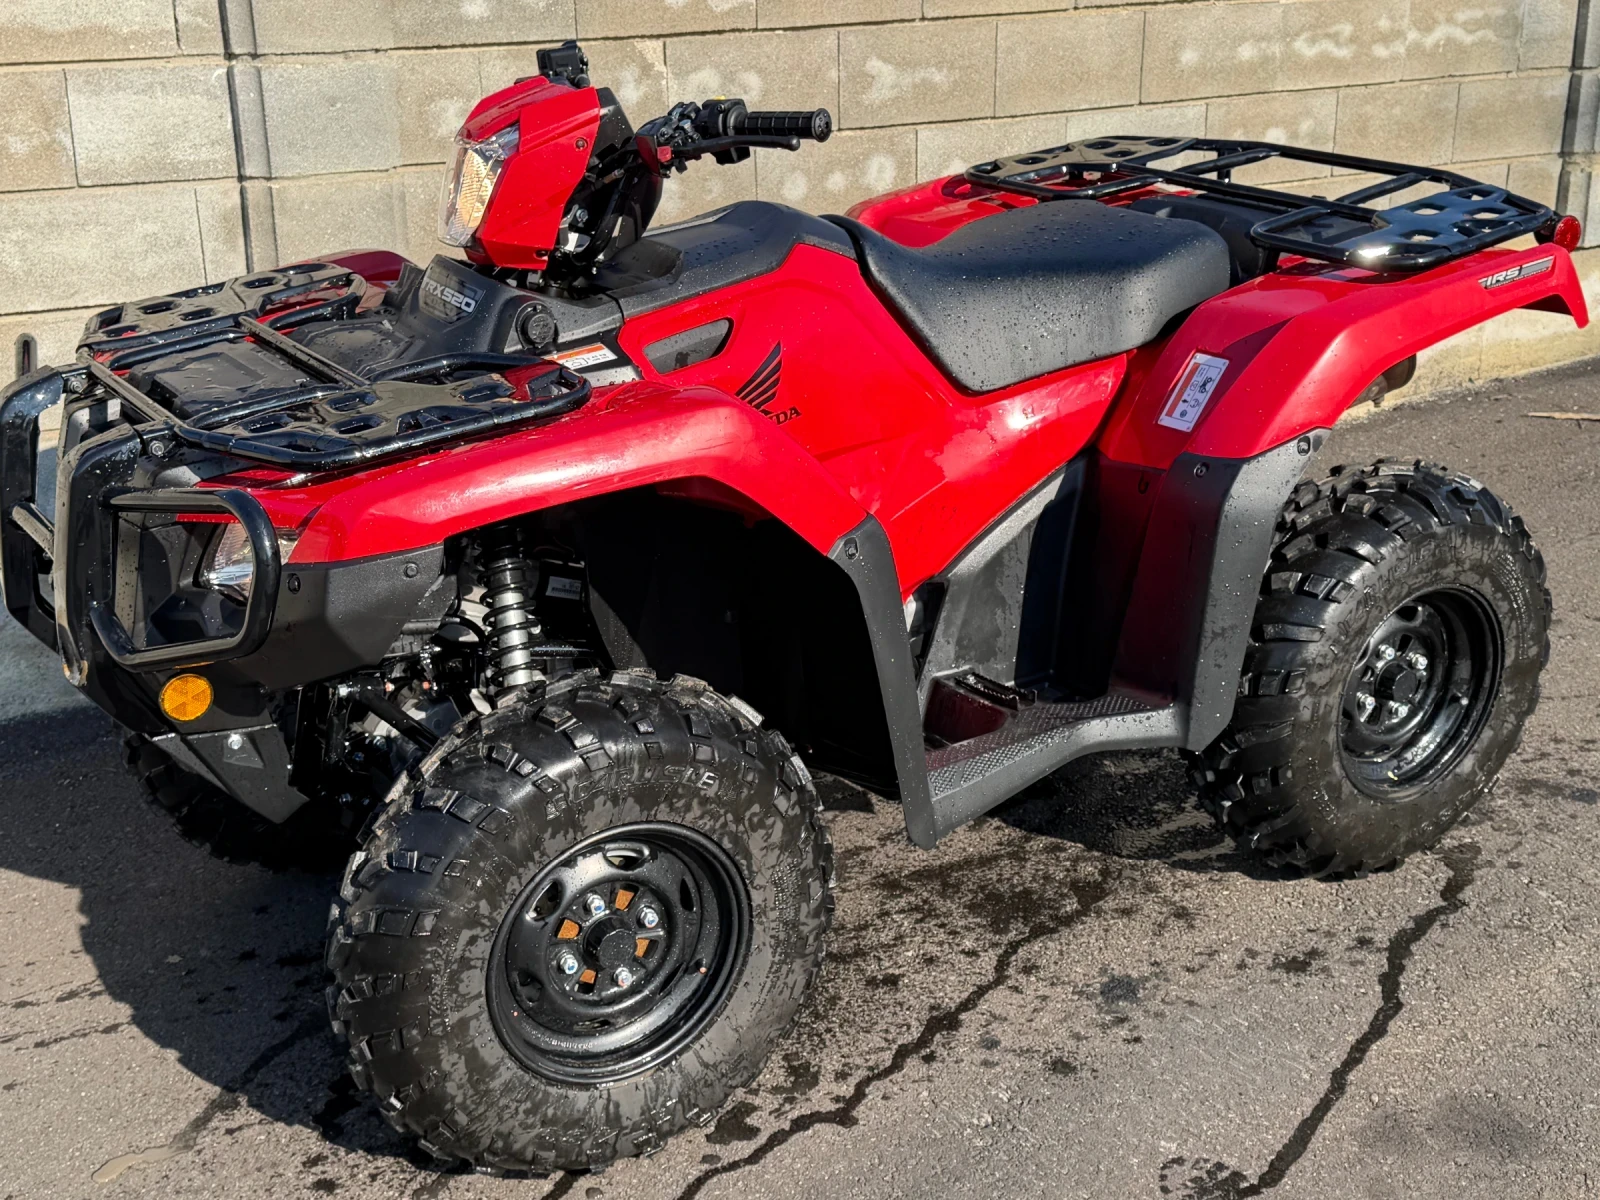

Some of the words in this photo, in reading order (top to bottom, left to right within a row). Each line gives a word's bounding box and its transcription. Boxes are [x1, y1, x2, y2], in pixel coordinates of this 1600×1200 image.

[1487, 266, 1520, 286] IRS
[421, 277, 476, 313] TRX520
[573, 764, 720, 804] CARLISLE
